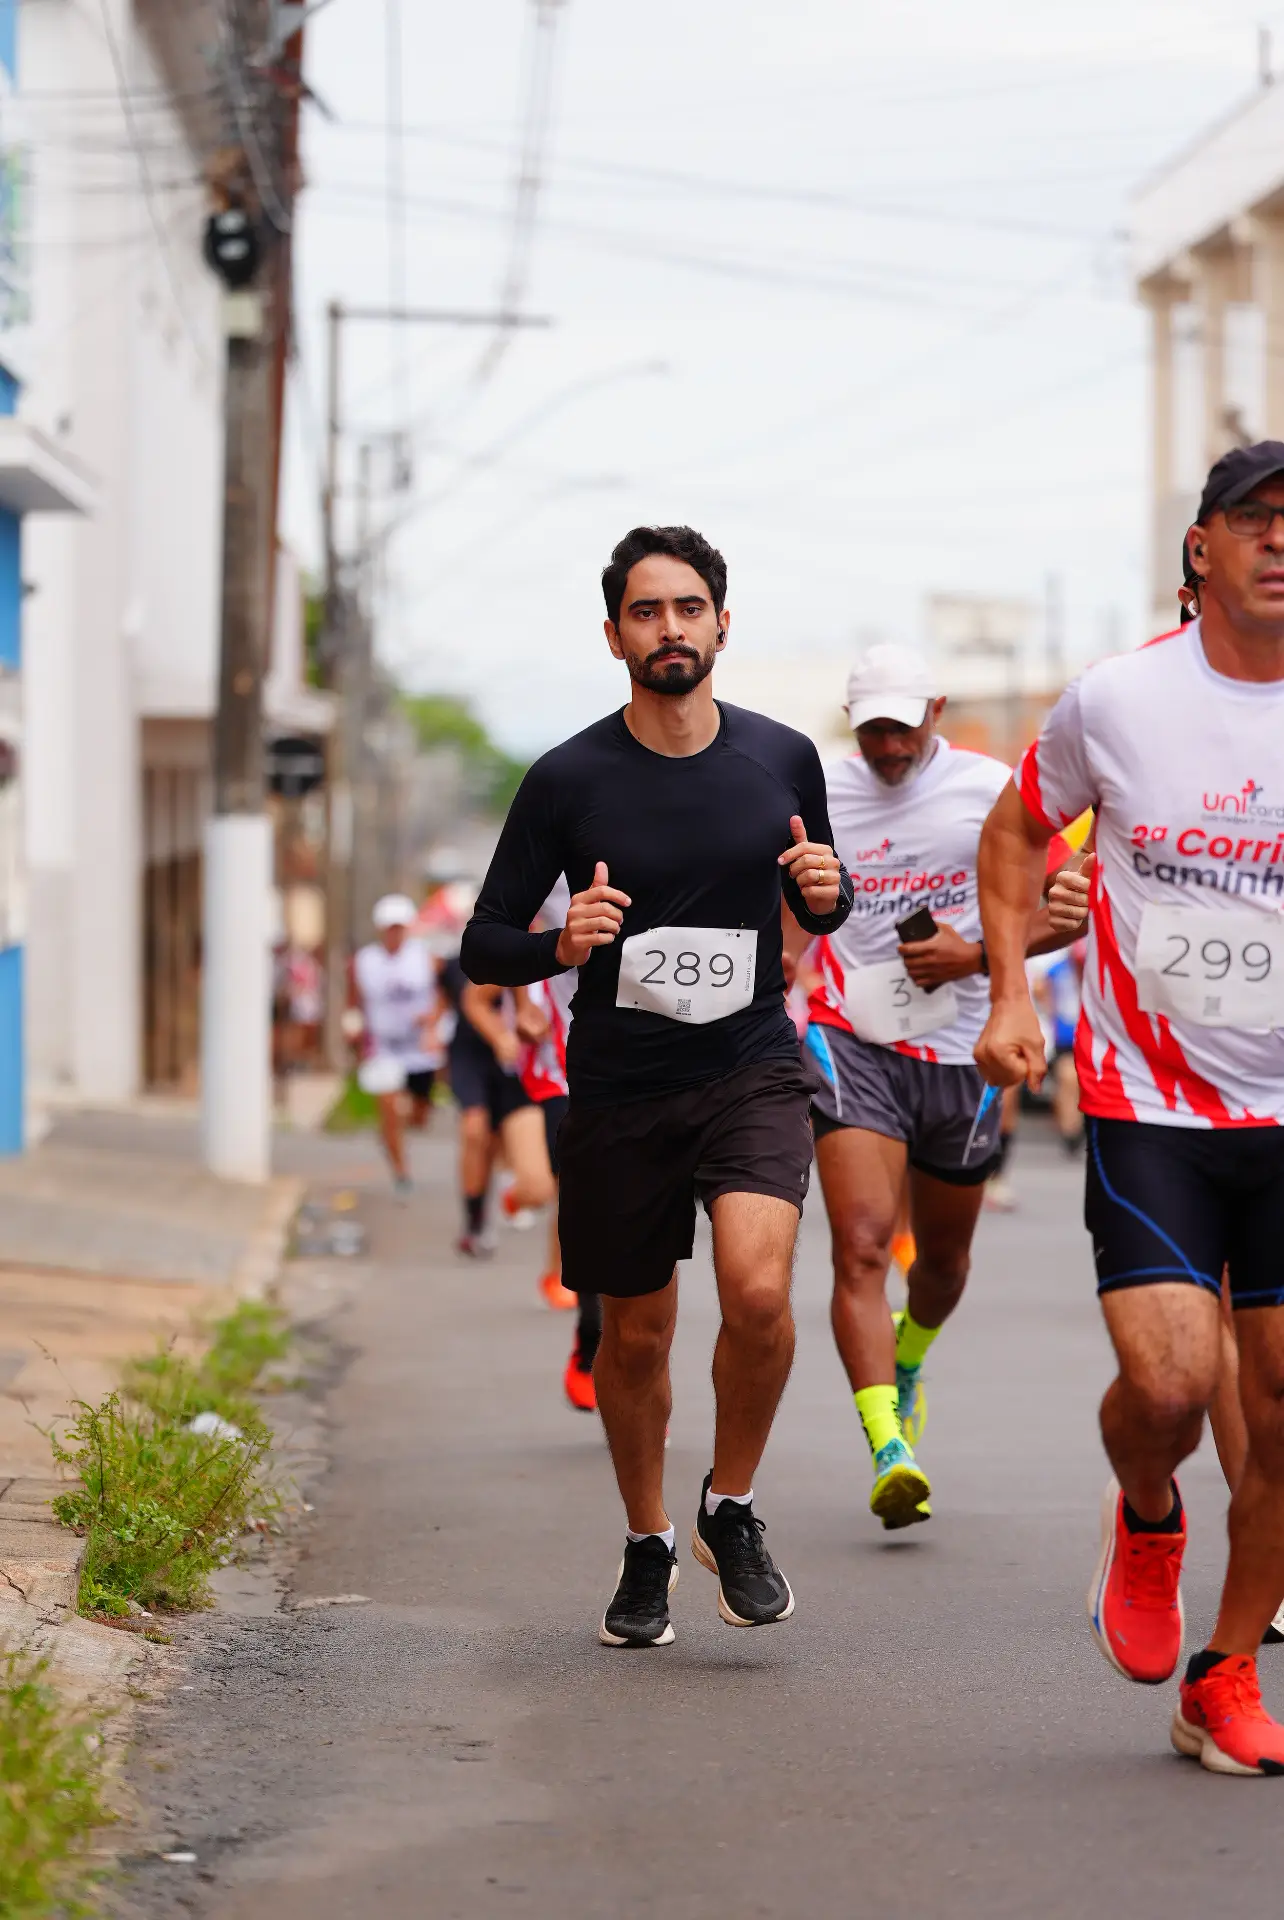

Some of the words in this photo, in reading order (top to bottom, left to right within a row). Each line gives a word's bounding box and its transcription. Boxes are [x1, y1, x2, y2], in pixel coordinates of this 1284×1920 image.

[1176, 828, 1284, 864] Corri
[951, 870, 967, 886] e
[1133, 852, 1284, 896] Caminh
[854, 889, 966, 916] minhada
[640, 949, 734, 988] 289
[1161, 935, 1271, 982] 299
[890, 978, 912, 1007] 3
